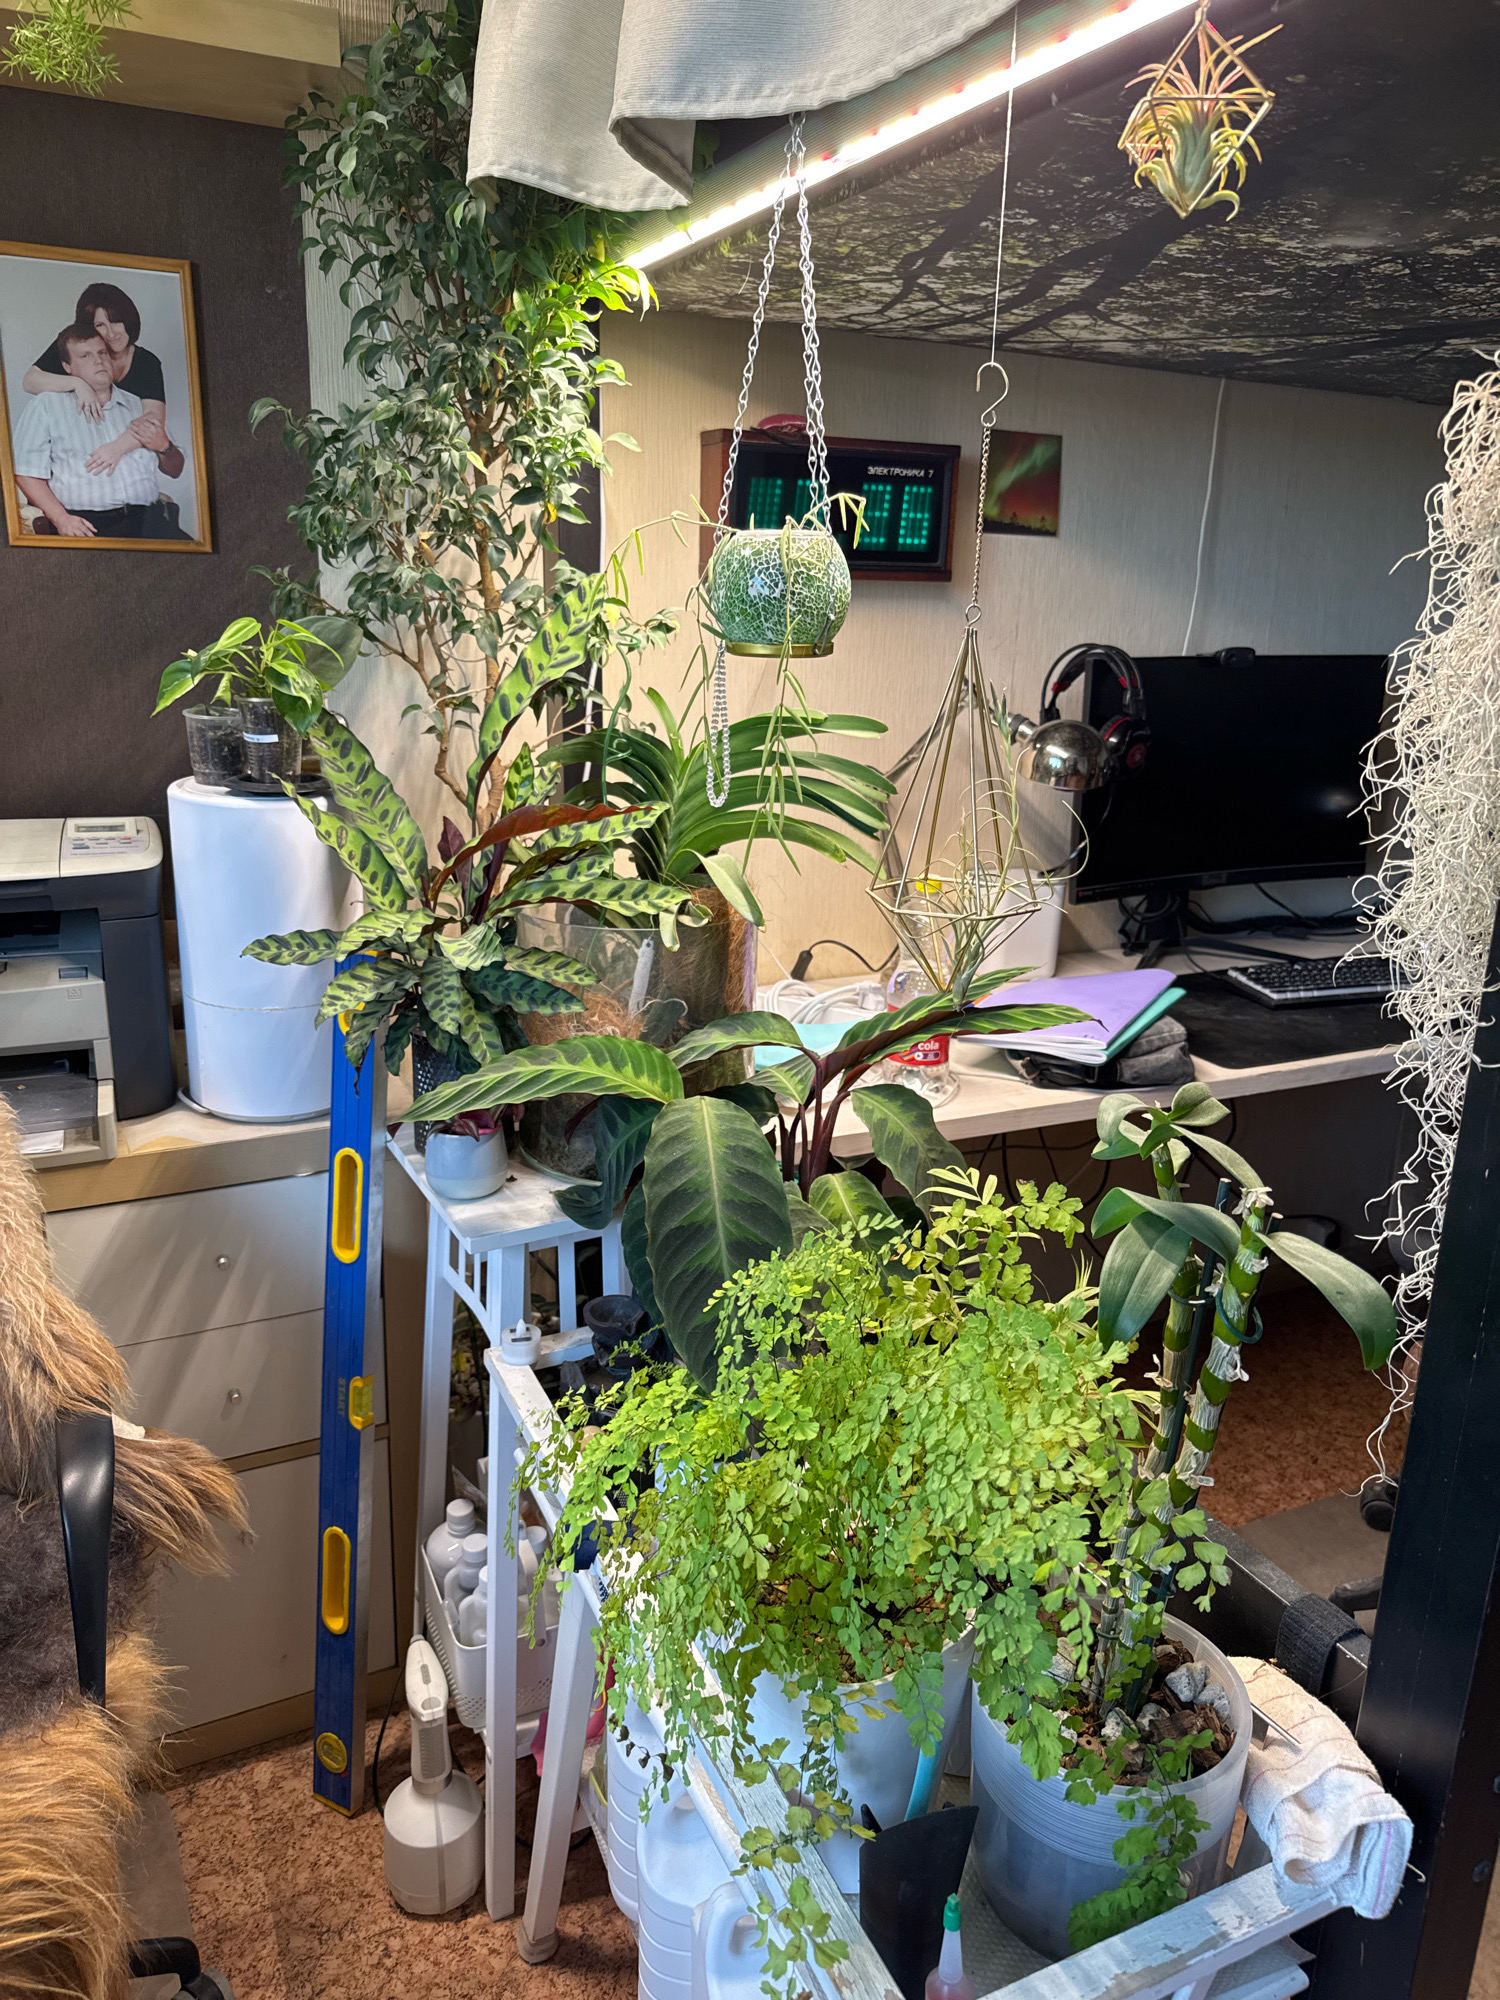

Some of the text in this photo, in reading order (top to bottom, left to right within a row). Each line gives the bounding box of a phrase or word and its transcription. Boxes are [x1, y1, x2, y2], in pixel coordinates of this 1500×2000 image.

[867, 466, 935, 479] ЭЛЕКТРОНИКА 7
[918, 1041, 939, 1050] cola
